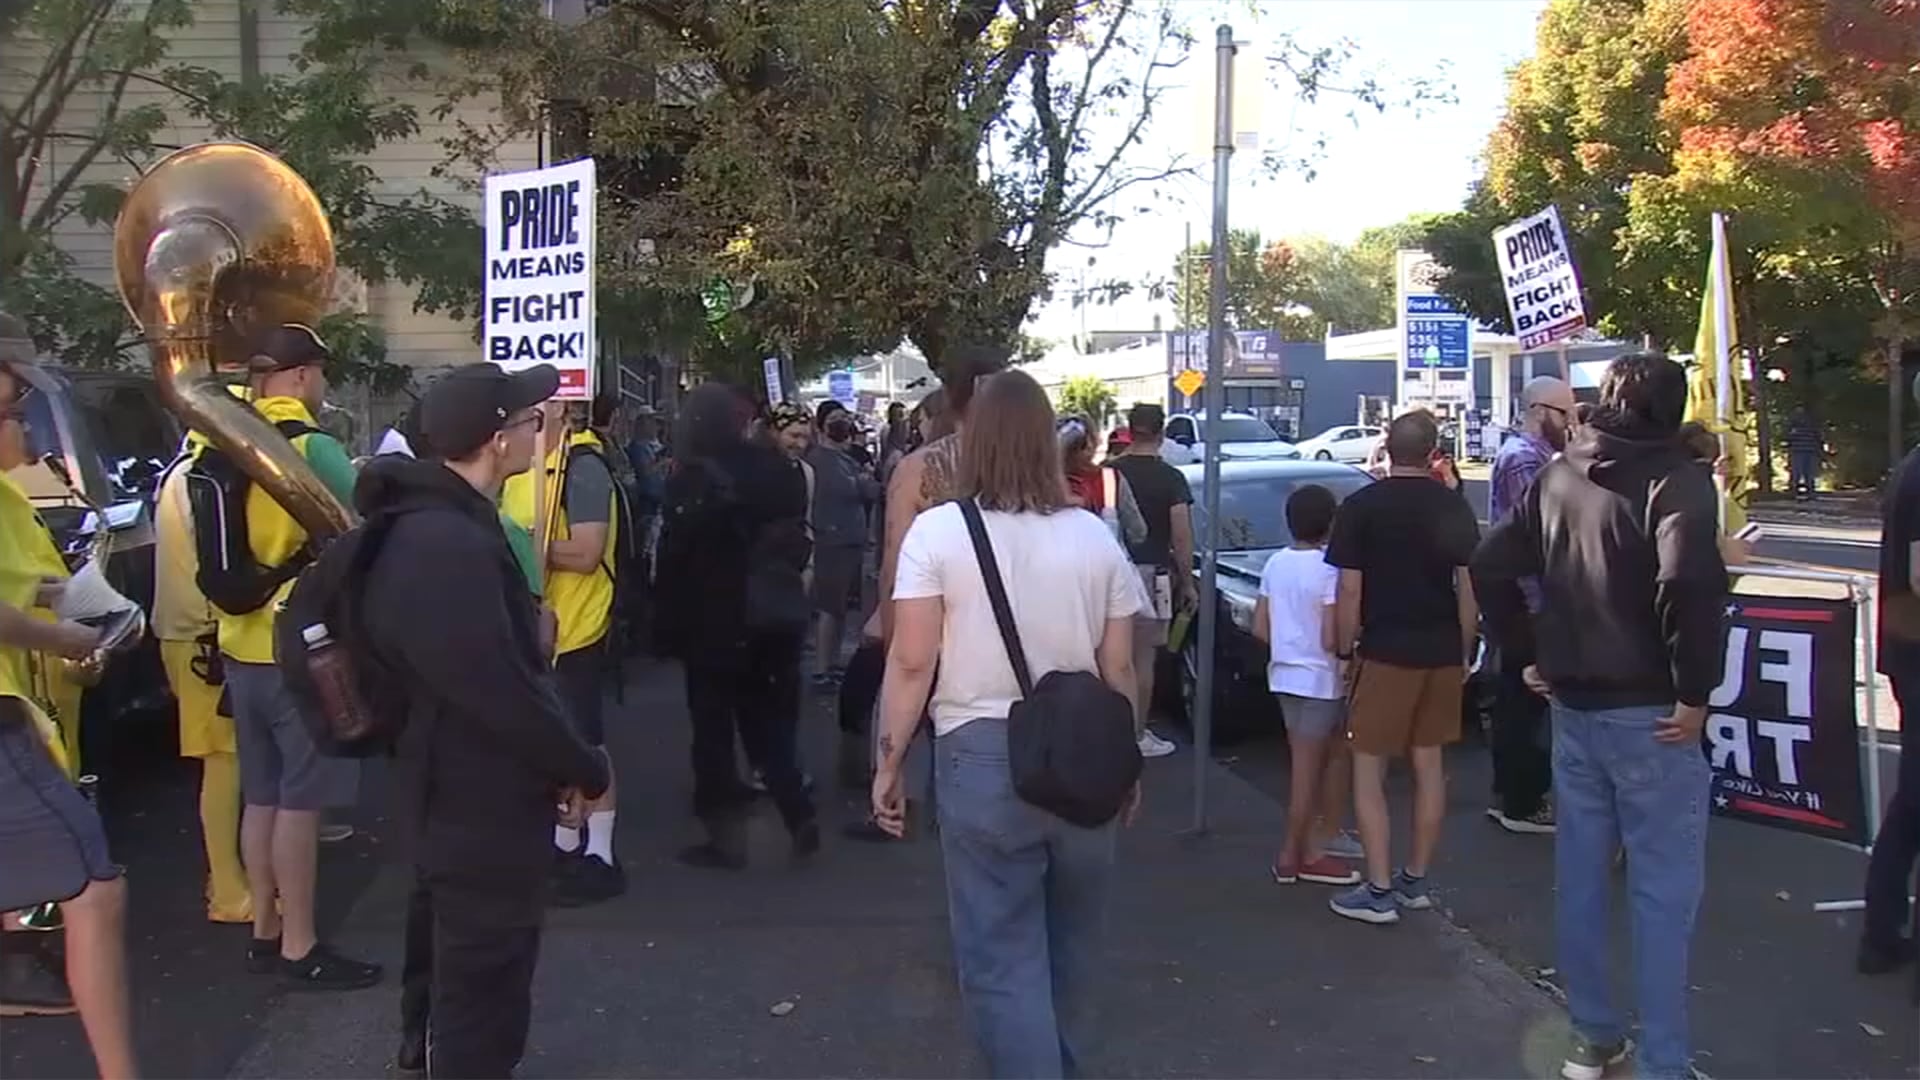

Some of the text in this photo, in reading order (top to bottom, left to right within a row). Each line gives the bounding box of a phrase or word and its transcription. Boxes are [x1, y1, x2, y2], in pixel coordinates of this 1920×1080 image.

[501, 180, 580, 251] PRIDE
[1505, 218, 1560, 270] PRIDE
[491, 252, 585, 280] MEANS
[1507, 253, 1567, 288] MEANS
[491, 291, 585, 324] FIGHT
[1408, 299, 1432, 310] Food
[1512, 275, 1571, 311] FIGHT
[490, 332, 584, 361] BACK!
